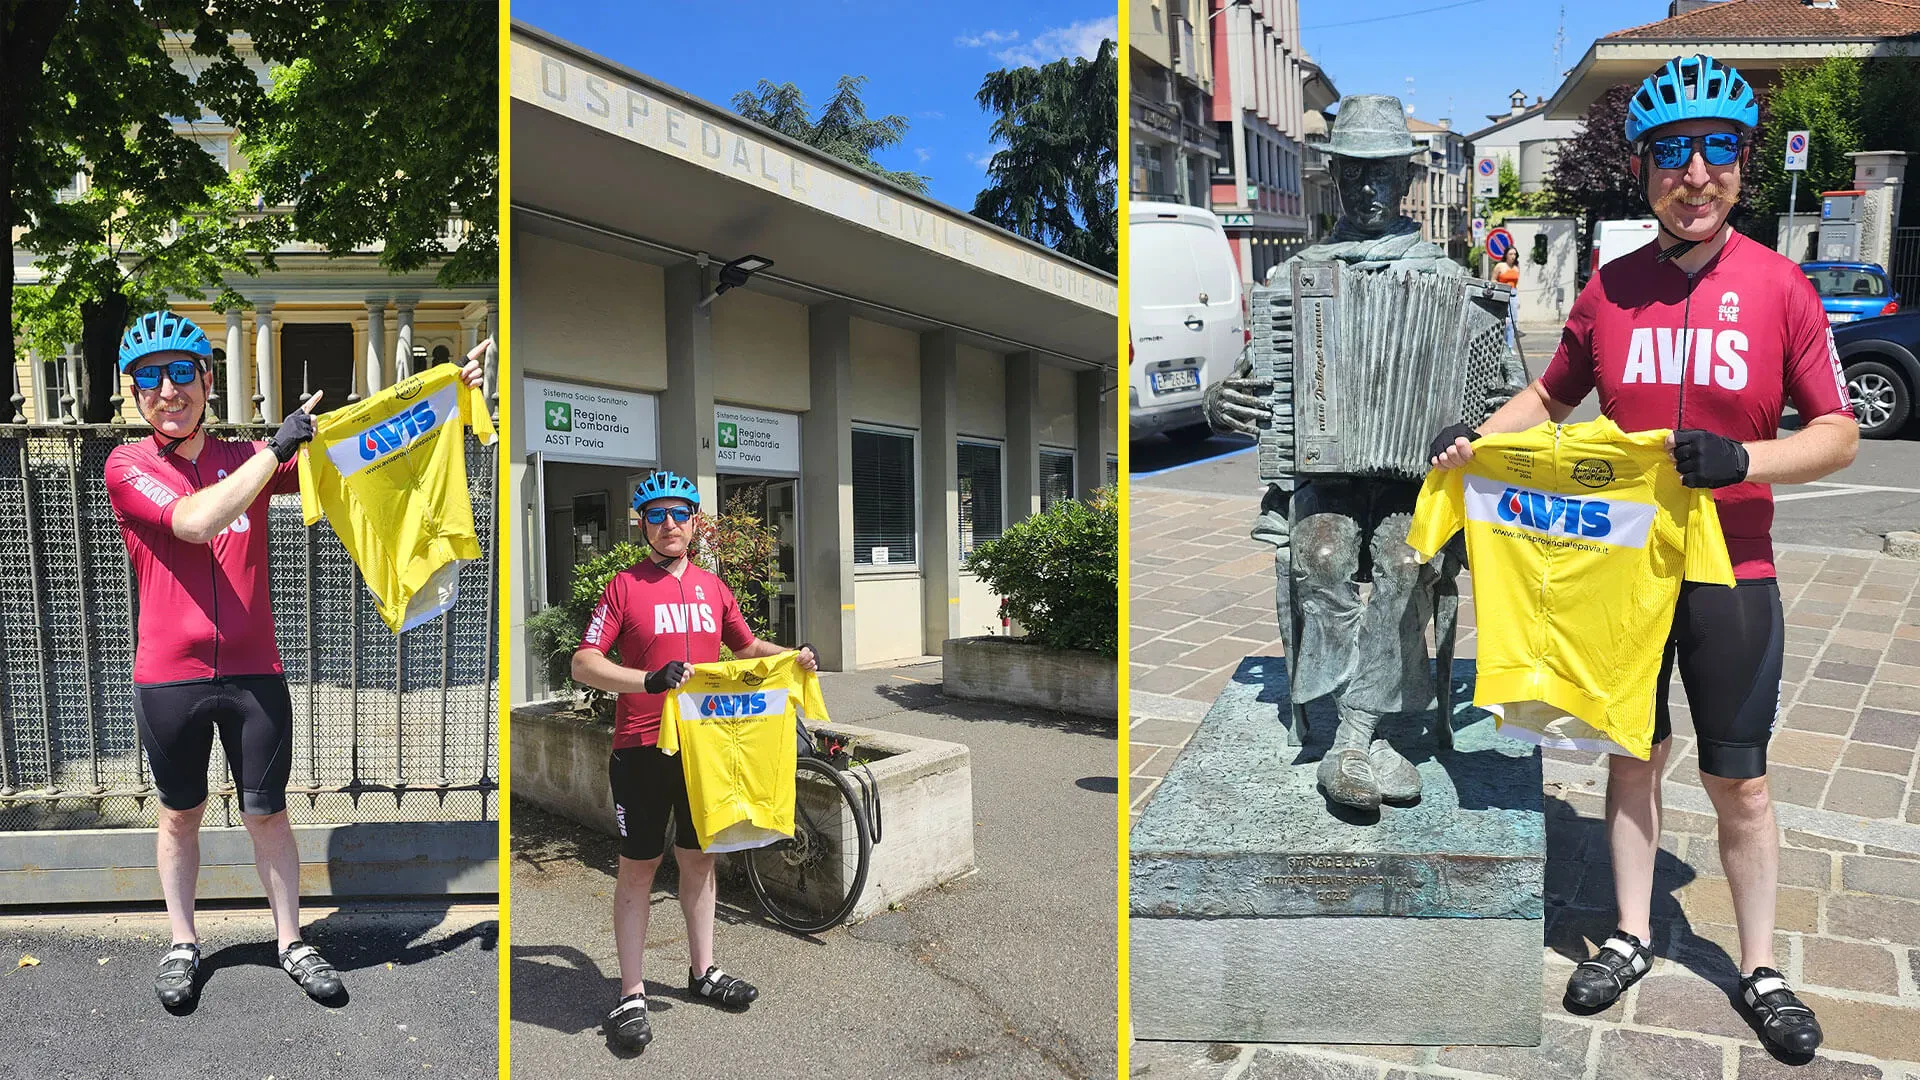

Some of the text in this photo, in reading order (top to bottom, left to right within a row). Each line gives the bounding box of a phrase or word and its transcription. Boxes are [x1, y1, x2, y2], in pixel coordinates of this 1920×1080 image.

[541, 55, 806, 192] OSPEDALE
[875, 193, 978, 256] CIVILE
[1622, 327, 1749, 391] AVIS
[543, 388, 628, 406] Sistema Socio Sanitario
[574, 409, 618, 424] Regione
[716, 411, 779, 426] Sistema Socio Sanitario
[358, 399, 437, 461] AVIS
[574, 419, 630, 434] Lombardia
[739, 428, 771, 440] Regione
[545, 434, 604, 449] ASST Pavia
[739, 437, 780, 449] Lombardia
[718, 450, 761, 463] ASST Pavia
[133, 476, 175, 507] AVIS
[1497, 487, 1612, 538] AVIS
[1491, 527, 1609, 555] www.avisprovincialepavia.it
[654, 603, 717, 635] AVIS
[700, 692, 767, 717] AVIS
[1316, 890, 1349, 901] 2022
